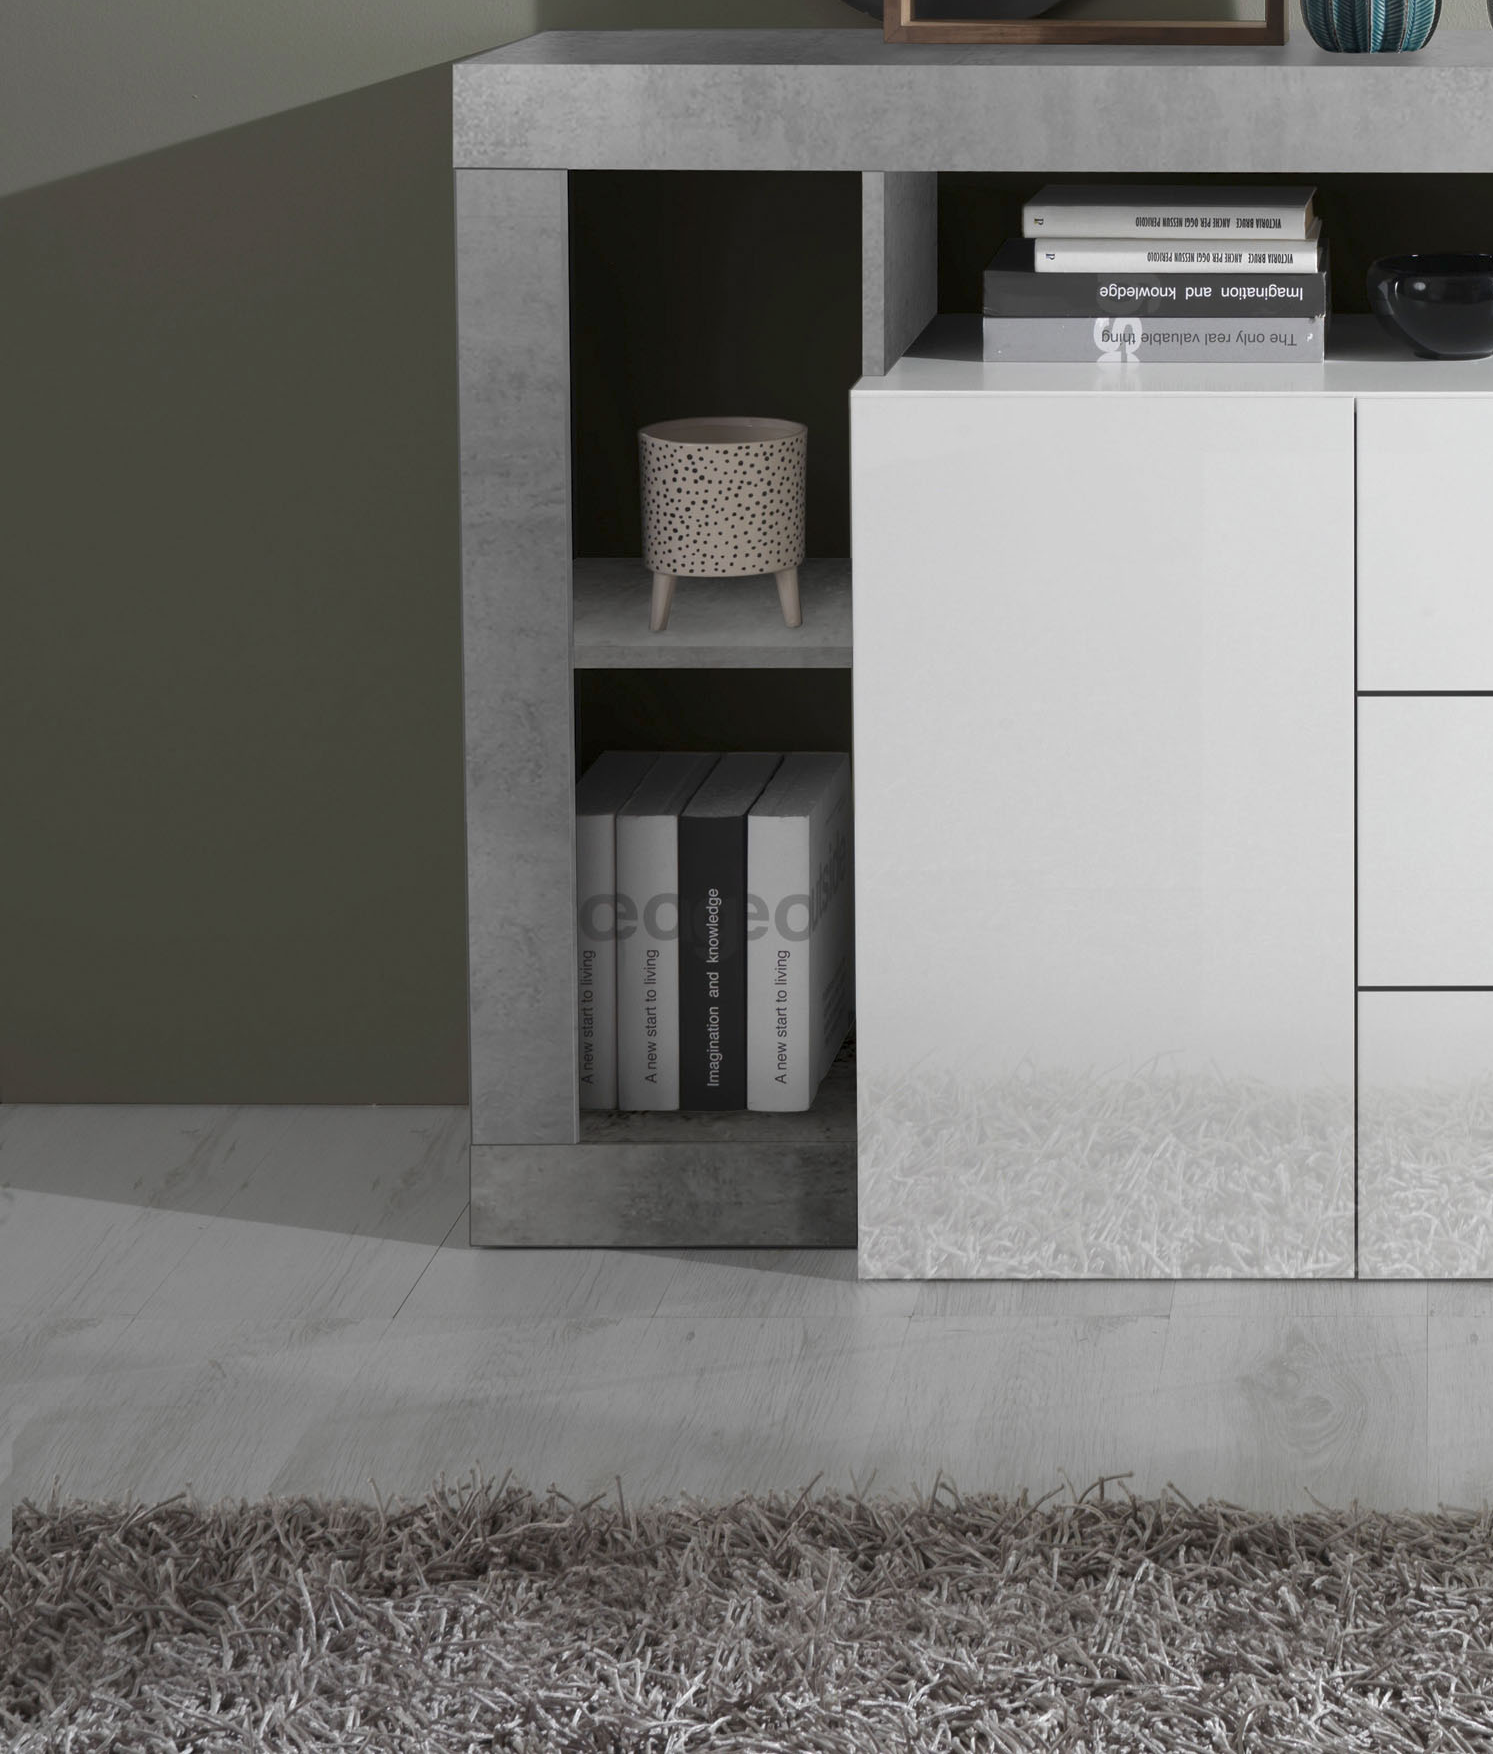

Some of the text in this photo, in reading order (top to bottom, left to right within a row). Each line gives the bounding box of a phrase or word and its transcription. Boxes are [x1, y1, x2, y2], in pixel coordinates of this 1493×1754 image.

[1135, 217, 1230, 228] ANCHE PER OGGI NESSUN PERICOLO
[1236, 217, 1281, 228] VICTORIA BRUCE
[1147, 252, 1242, 263] ANCHE PER OGGI NESSUN PERICOLO
[1248, 252, 1293, 263] VICTORIA BRUCE
[1100, 284, 1303, 300] Imagination and knowledge
[1101, 329, 1297, 345] The only real valuable thing
[706, 888, 723, 1087] Imagination and knowledge
[580, 950, 596, 1085] A new start to living
[643, 949, 659, 1084] A new start to living
[774, 950, 790, 1084] A new start to living
